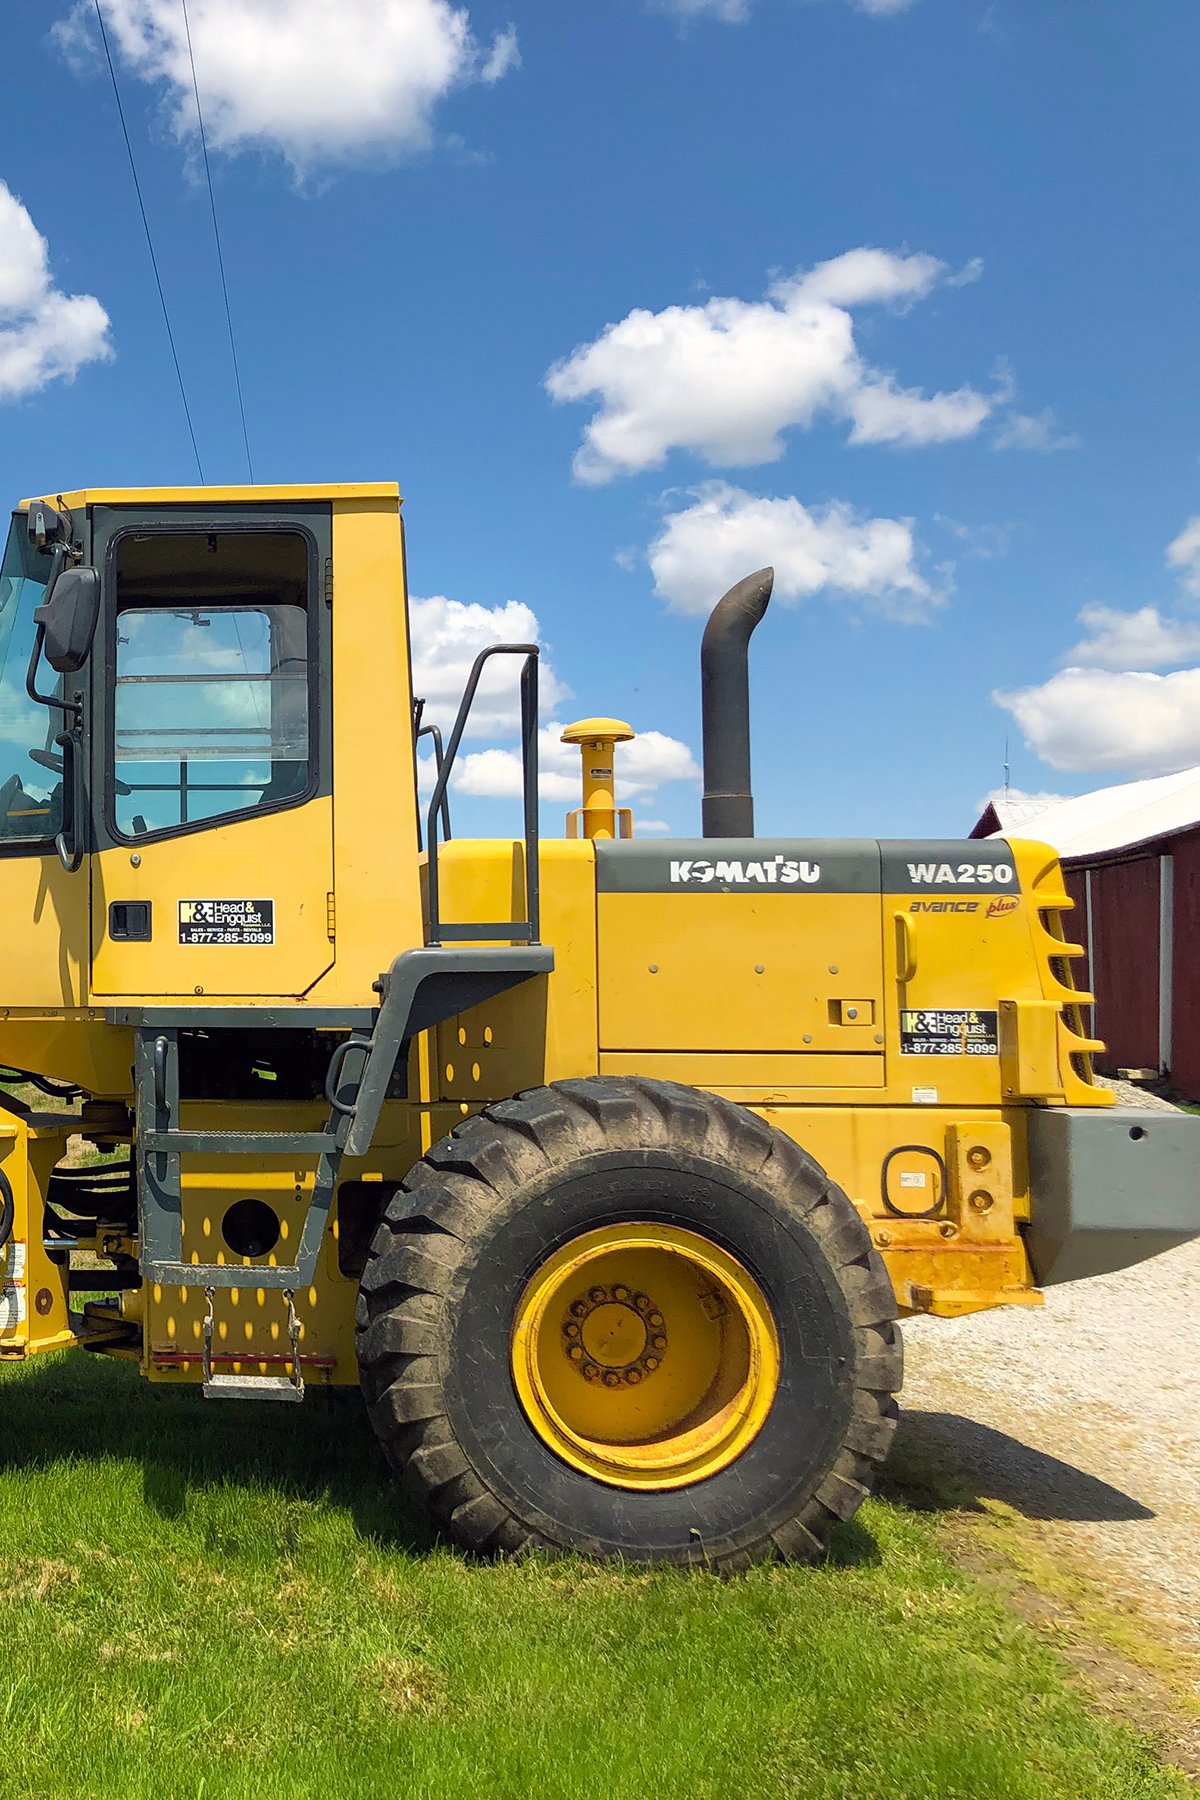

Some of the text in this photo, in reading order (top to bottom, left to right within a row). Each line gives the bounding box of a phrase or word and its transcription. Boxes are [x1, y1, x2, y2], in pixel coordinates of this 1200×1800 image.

[670, 855, 820, 884] KOMATSU
[907, 864, 1013, 884] WA250
[214, 902, 255, 913] Head &
[909, 899, 1016, 918] avance plus
[214, 912, 262, 926] Engquist
[180, 933, 272, 942] 1-877-285-5099
[937, 1012, 979, 1023] Head &
[902, 1043, 996, 1053] 1-877-285-5099
